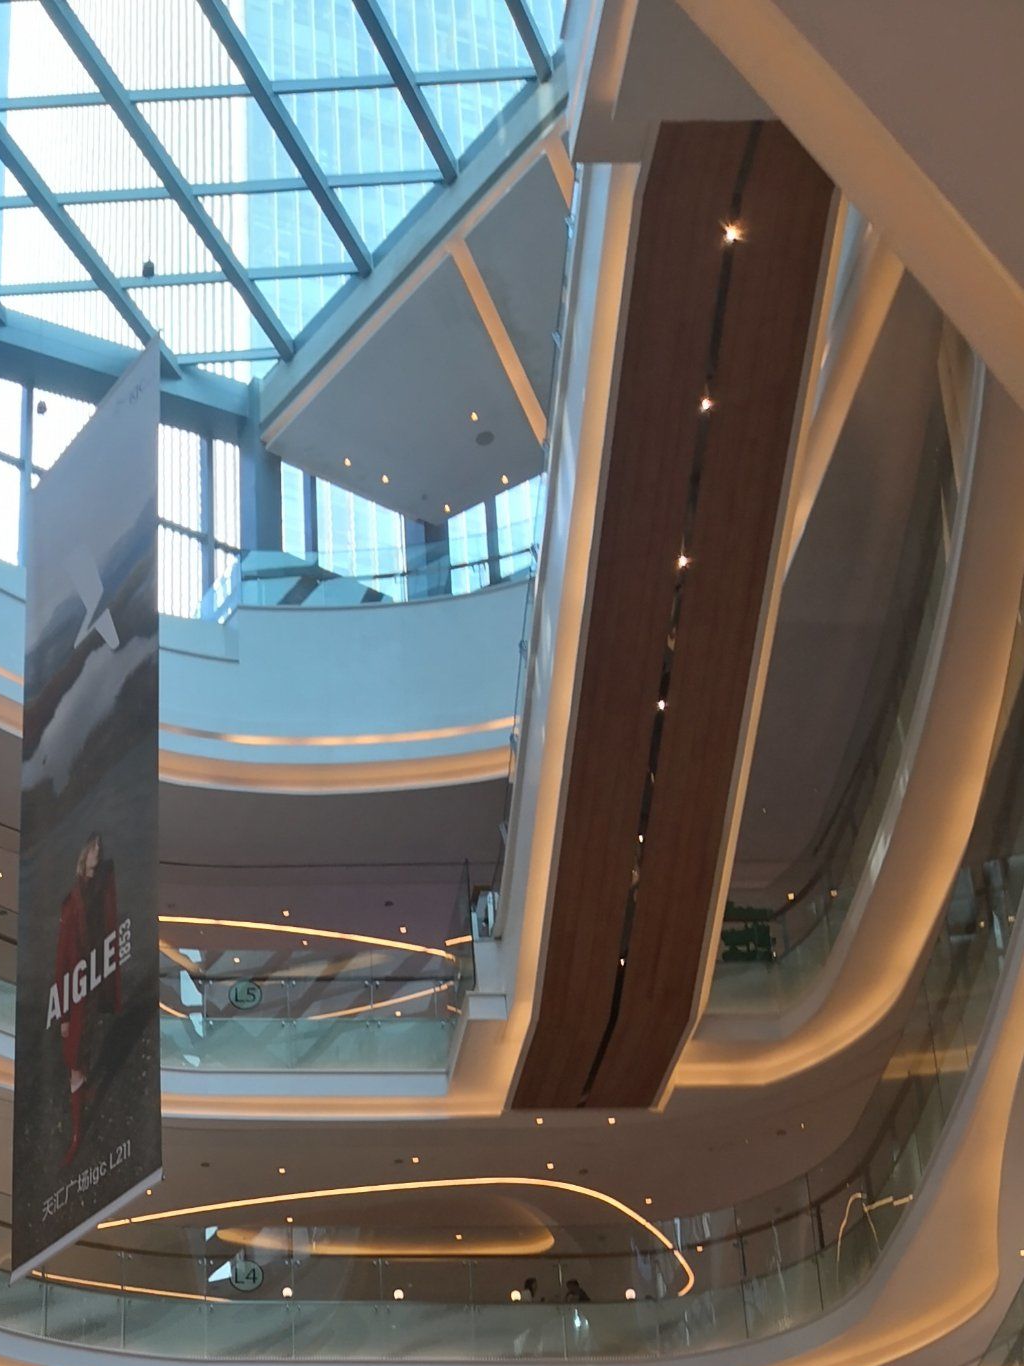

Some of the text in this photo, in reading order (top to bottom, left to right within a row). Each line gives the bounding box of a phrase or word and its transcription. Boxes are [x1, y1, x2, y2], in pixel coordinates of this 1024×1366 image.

[119, 917, 132, 967] 1853
[45, 930, 117, 1030] AIGLE
[234, 986, 257, 1003] L5
[109, 1139, 132, 1170] L211
[234, 1267, 258, 1285] L4
